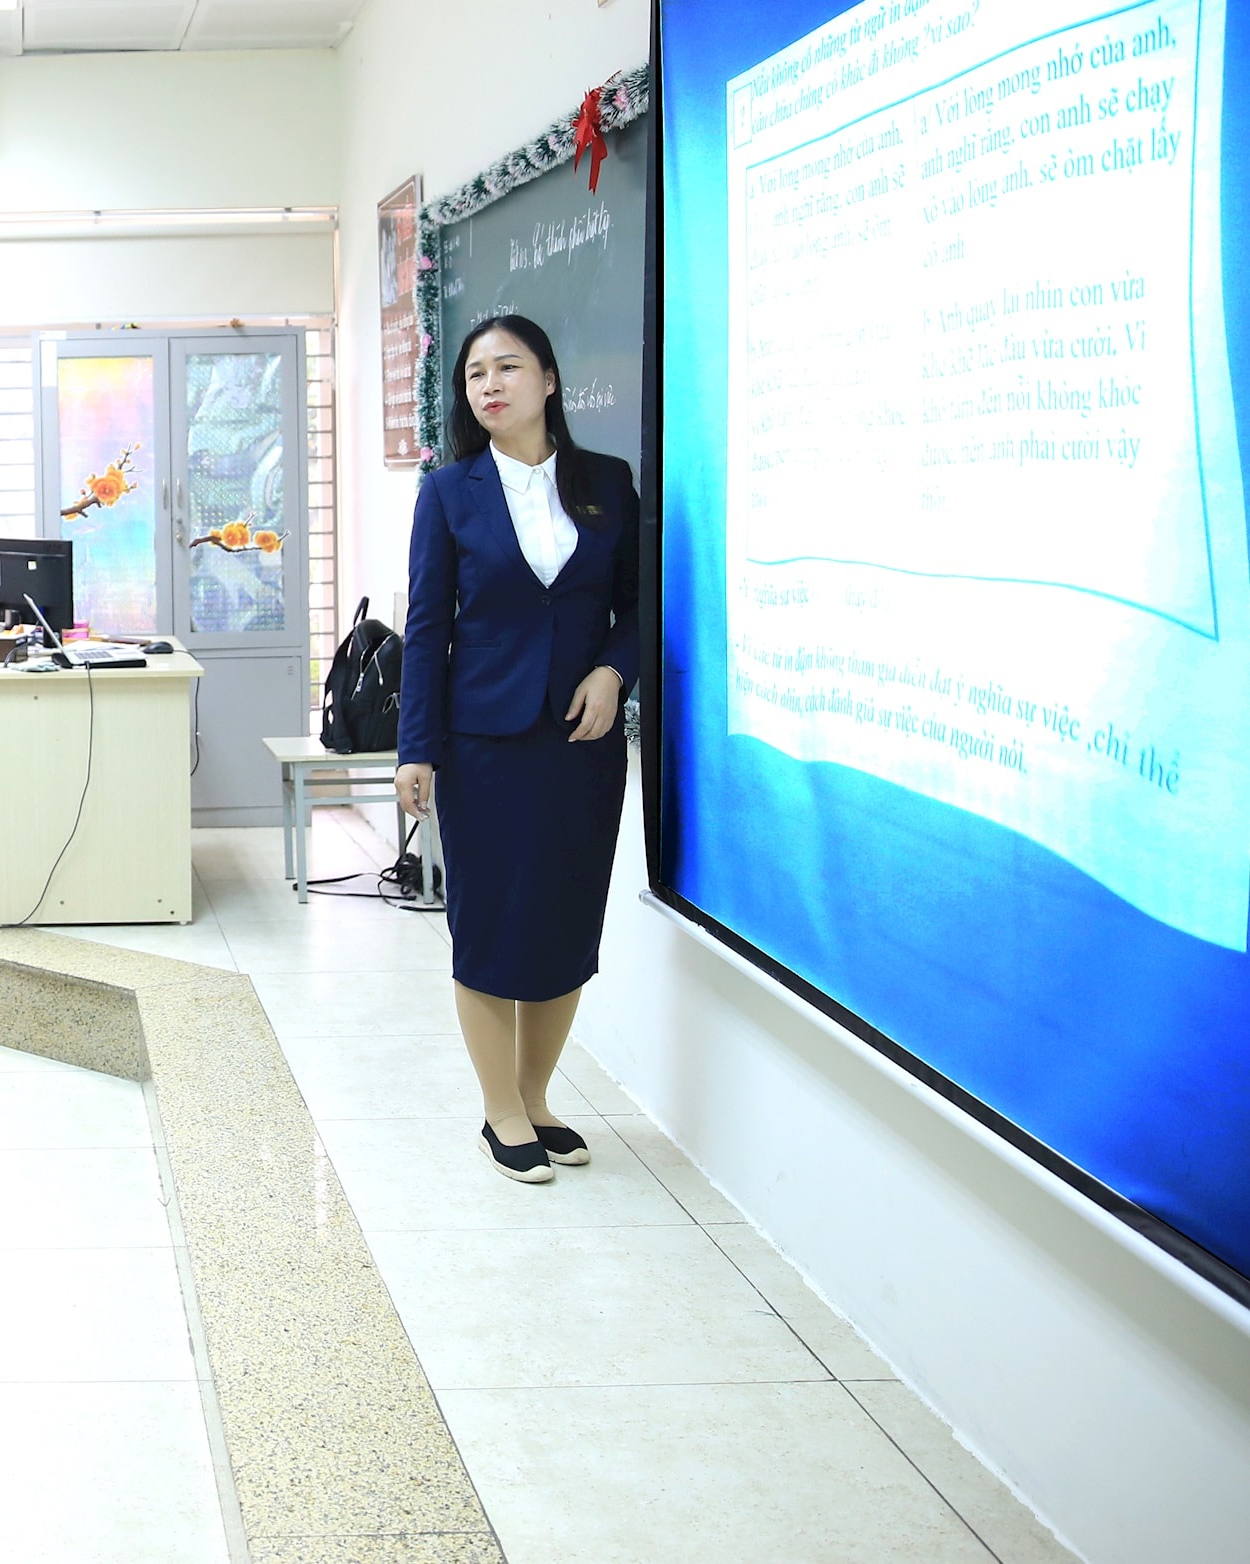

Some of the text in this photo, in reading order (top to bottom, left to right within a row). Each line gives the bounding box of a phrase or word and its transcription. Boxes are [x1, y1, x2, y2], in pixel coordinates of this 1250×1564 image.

[997, 64, 1041, 100] mong
[1047, 42, 1083, 81] nhớ
[1090, 35, 1125, 69] của
[1020, 111, 1051, 139] con
[1056, 93, 1091, 130] anh
[1097, 87, 1120, 121] sẽ
[1125, 76, 1175, 113] chạy
[1101, 137, 1144, 174] chặt
[1150, 116, 1182, 166] lấy
[1069, 282, 1104, 308] con
[1110, 268, 1146, 303] vừa
[1037, 379, 1092, 419] không
[1016, 698, 1037, 728] sự
[1043, 703, 1081, 743] việc
[950, 730, 995, 761] người
